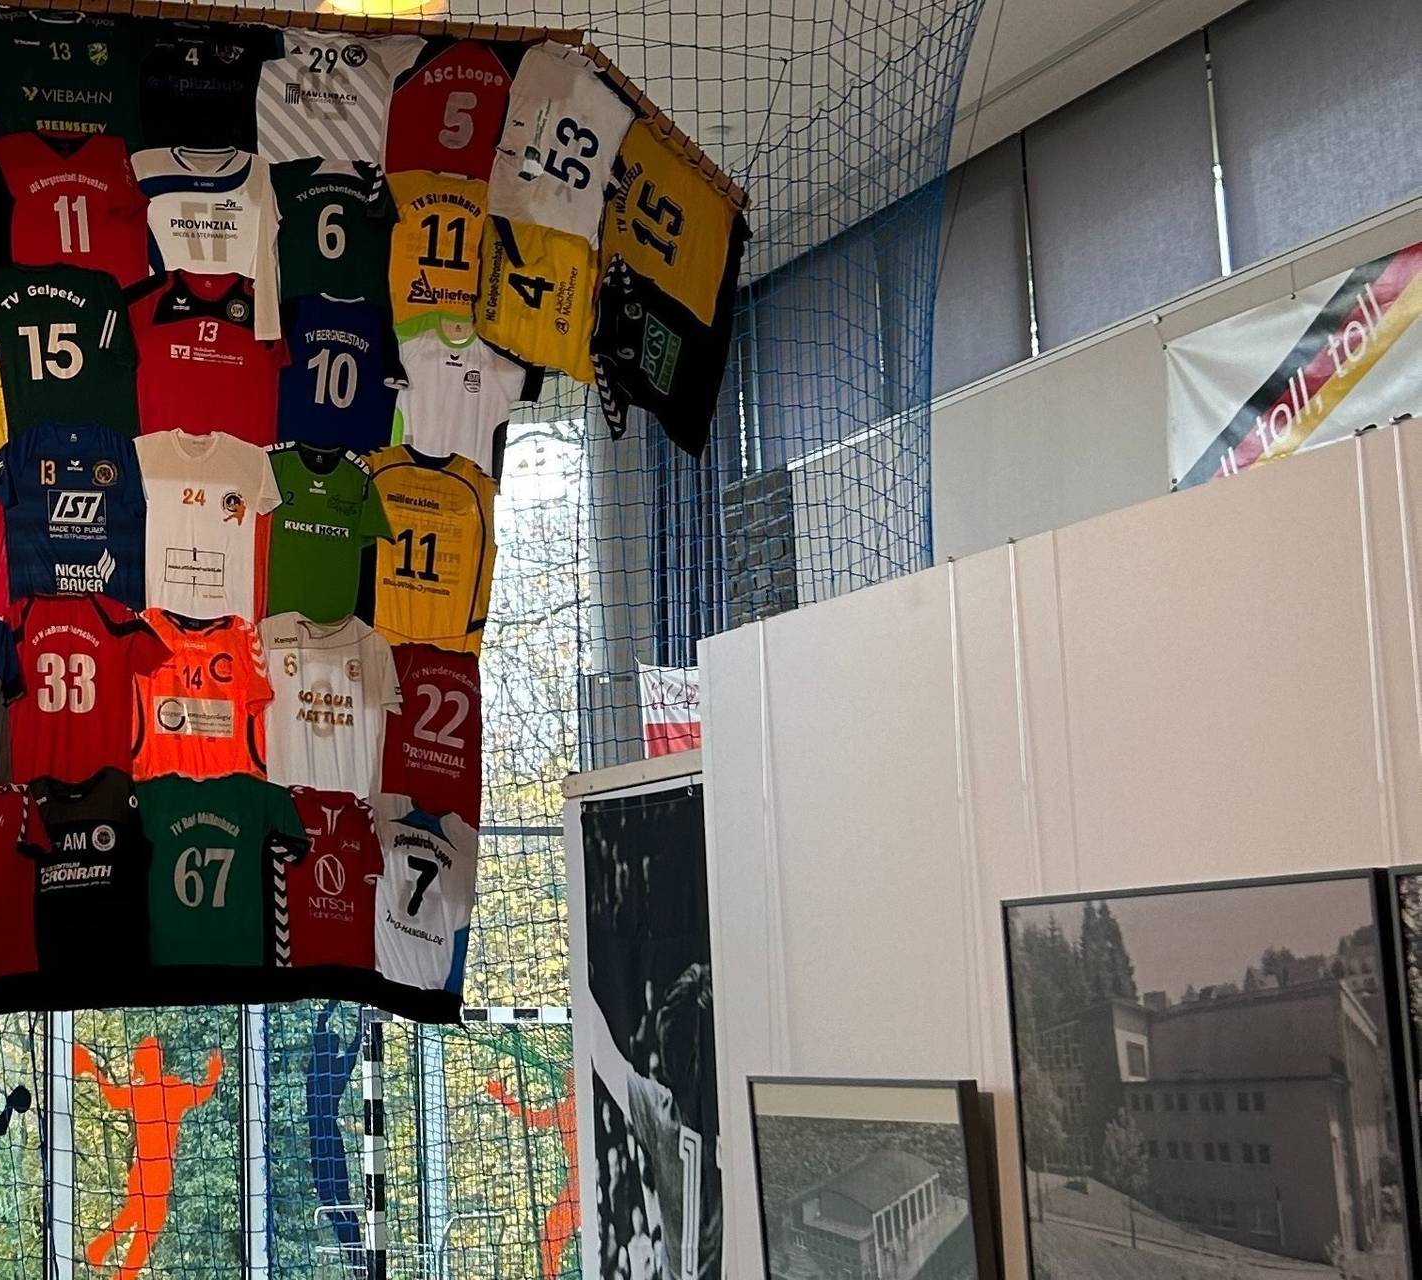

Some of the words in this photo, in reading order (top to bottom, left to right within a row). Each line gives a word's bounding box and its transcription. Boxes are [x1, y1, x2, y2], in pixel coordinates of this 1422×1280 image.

[49, 41, 72, 61] 13
[185, 47, 200, 66] 4
[309, 48, 338, 74] 29
[423, 67, 453, 86] ASC
[457, 65, 504, 86] Loope
[41, 88, 113, 104] VIEBAHN
[438, 91, 478, 149] 5
[543, 117, 599, 189] 53
[296, 190, 308, 203] TV
[410, 200, 425, 211] TV
[53, 194, 91, 253] 11
[170, 218, 238, 231] PROVINZIAL
[317, 203, 346, 260] 6
[631, 179, 685, 267] 15
[418, 214, 470, 271] 11
[0, 291, 20, 310] TV
[27, 284, 86, 308] Gelpetal
[508, 272, 556, 309] 4
[197, 320, 219, 342] 13
[304, 333, 316, 344] TV
[1328, 283, 1384, 378] toll
[17, 322, 84, 381] 15
[307, 348, 358, 409] 10
[40, 459, 57, 486] 13
[57, 495, 97, 519] IST
[182, 488, 206, 506] 24
[285, 491, 295, 506] 2
[284, 520, 313, 533] KUCK
[395, 528, 440, 582] 11
[55, 563, 101, 578] NICKEL
[60, 577, 104, 592] BAUER
[36, 652, 97, 714] 33
[183, 665, 203, 690] 14
[413, 683, 470, 749] 22
[62, 831, 87, 852] AM
[41, 864, 113, 885] CRONRATH
[173, 846, 236, 908] 67
[407, 854, 439, 917] 7
